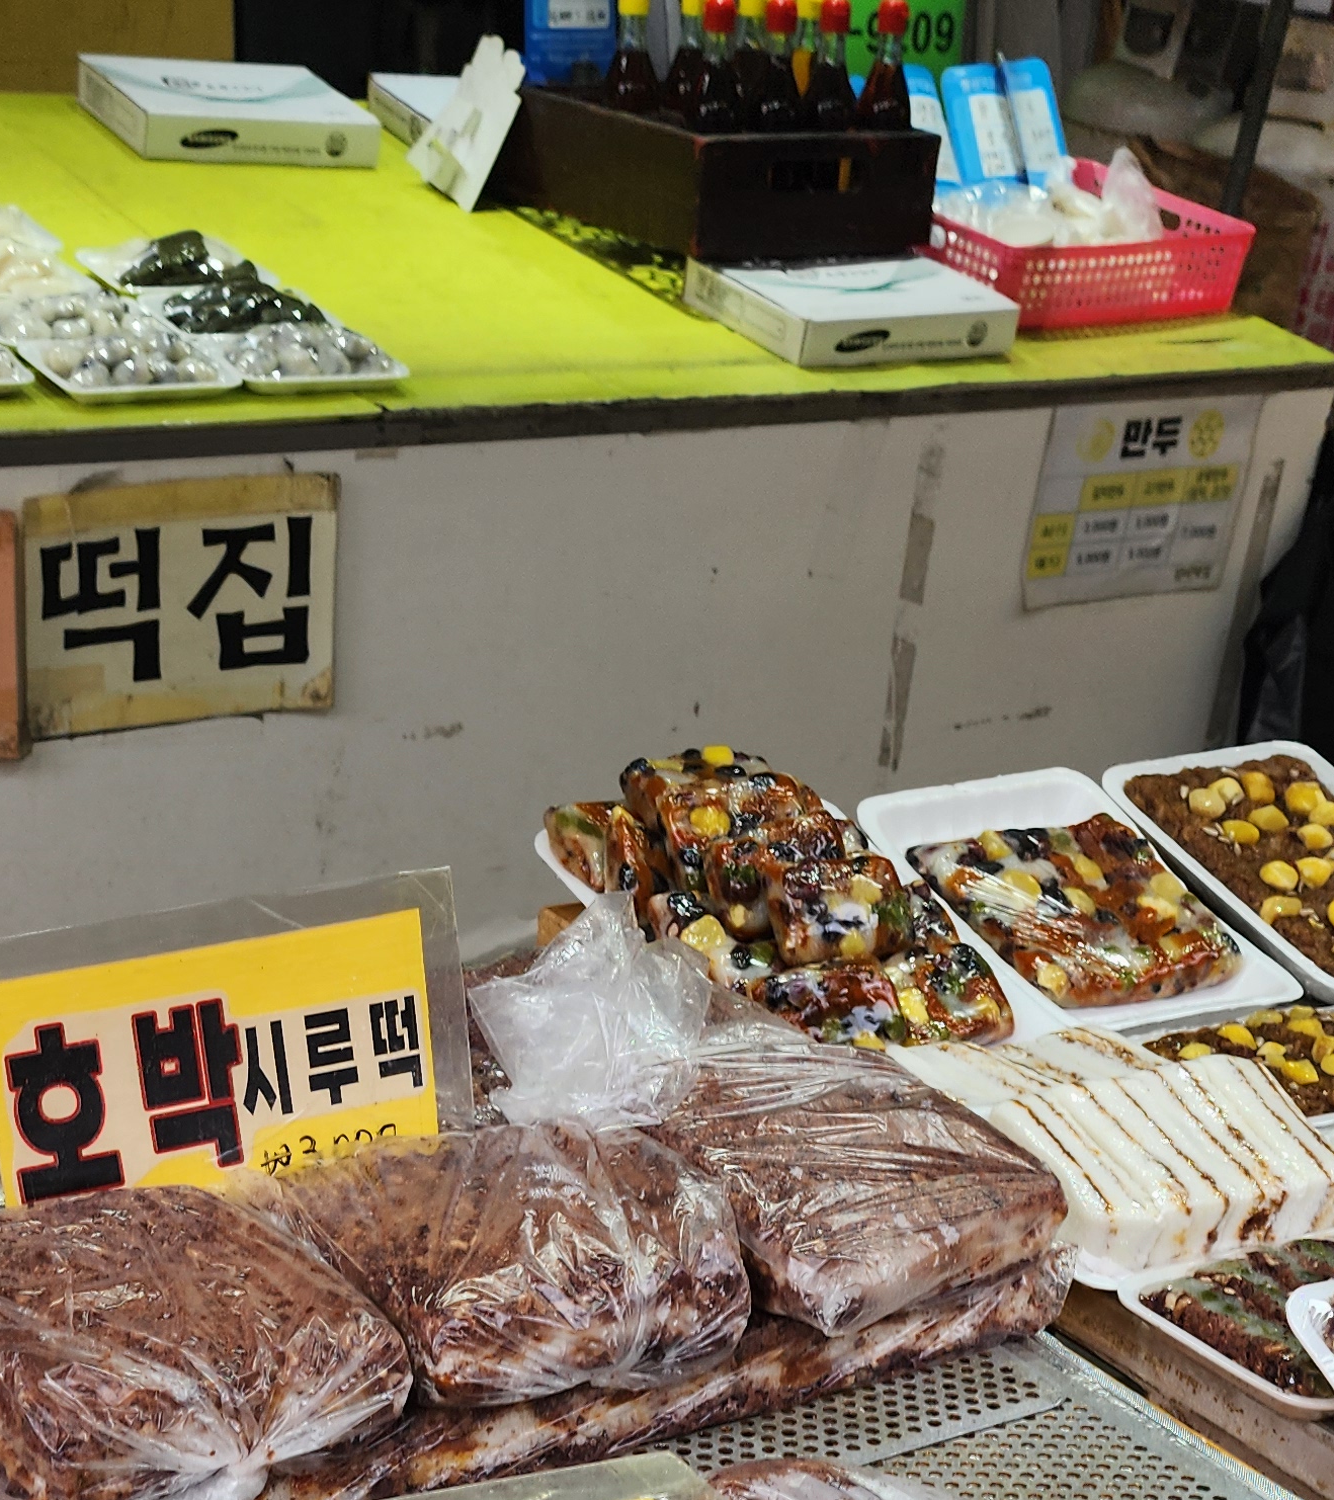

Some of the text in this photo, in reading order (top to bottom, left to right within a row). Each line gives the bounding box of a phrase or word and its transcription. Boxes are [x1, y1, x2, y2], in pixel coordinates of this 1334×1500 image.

[1120, 415, 1183, 460] 만두
[40, 516, 312, 682] 떡집
[5, 996, 425, 1206] 호박시루떡
